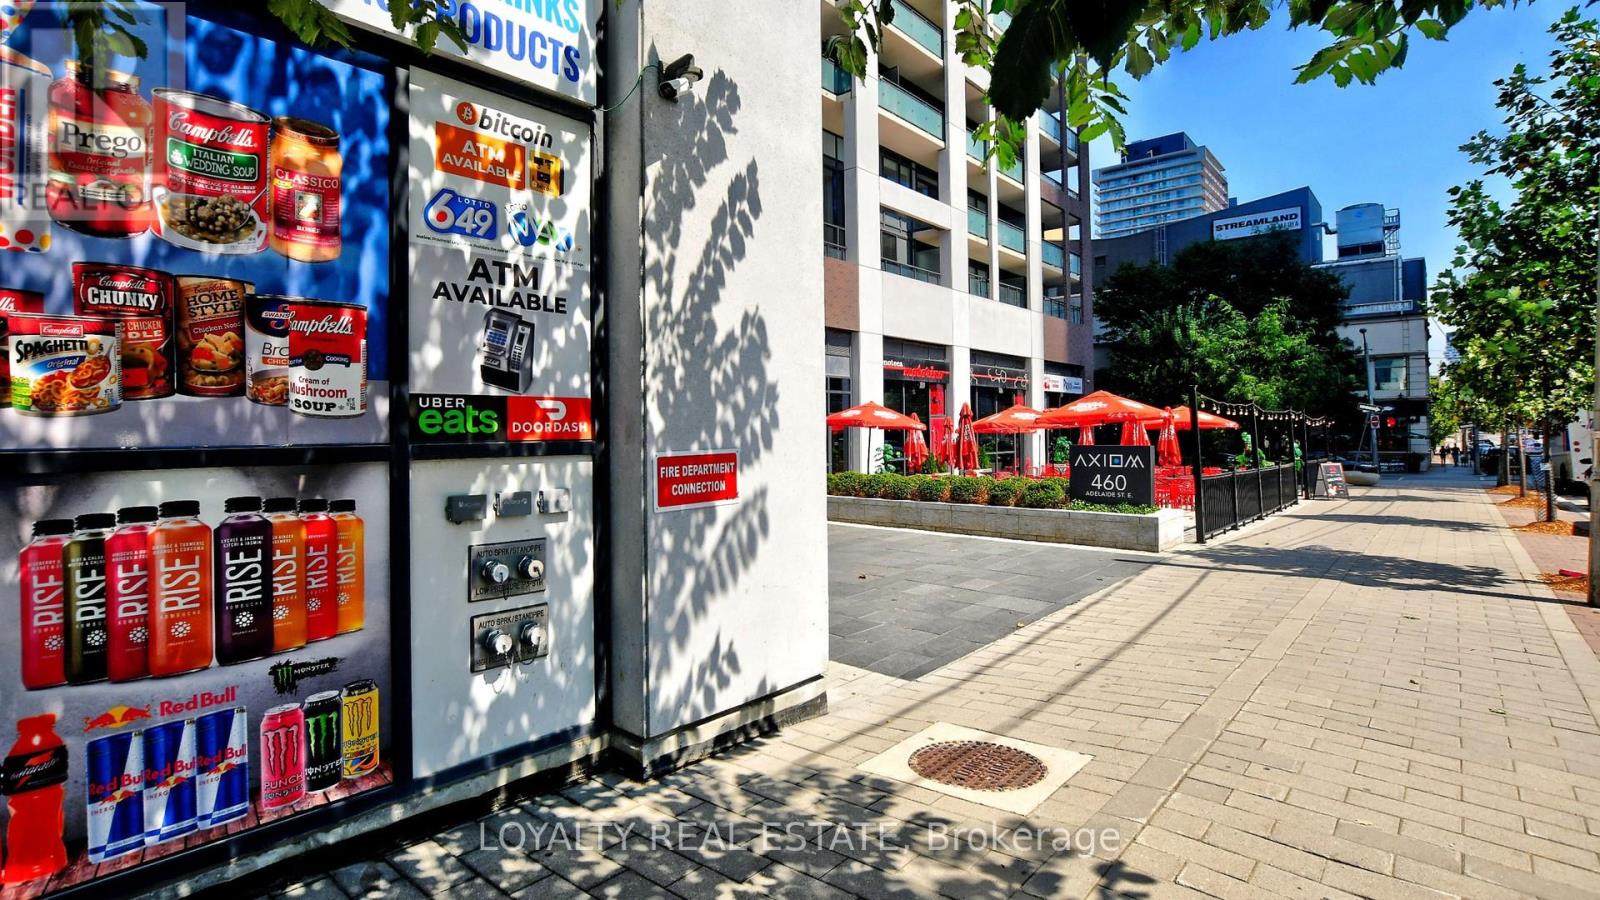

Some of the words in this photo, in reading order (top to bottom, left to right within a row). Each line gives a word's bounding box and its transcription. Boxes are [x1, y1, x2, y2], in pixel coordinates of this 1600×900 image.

[412, 0, 580, 82] RODUCTS
[168, 111, 257, 148] Campbell's
[478, 108, 553, 149] bitcoin
[62, 121, 142, 158] Prego
[192, 147, 235, 164] ITALIAN
[462, 139, 506, 163] ATM
[183, 153, 231, 177] WEDDING
[232, 166, 256, 178] SOUP
[442, 153, 522, 183] AVAILABLE
[275, 168, 339, 189] CLASSICO
[457, 197, 491, 209] LOTTO
[1215, 213, 1299, 232] STREAMLAND
[99, 275, 146, 290] Campbell's
[468, 258, 539, 290] ATM
[87, 286, 159, 310] CHUNKY
[186, 289, 238, 307] HOME
[432, 281, 568, 315] AVAILABLE
[188, 301, 241, 317] STYLE
[42, 324, 80, 335] Campbell's
[127, 321, 161, 331] CHICKEN
[193, 326, 223, 334] Chicken
[298, 376, 320, 385] Cream
[289, 382, 348, 398] Mushroom
[294, 398, 337, 412] SOUP
[418, 397, 466, 408] UBER
[418, 405, 499, 435] eats
[512, 421, 588, 433] DOORDASH
[1074, 453, 1145, 469] AXIOM
[660, 466, 680, 479] FIRE
[681, 462, 736, 477] DEPARTMENT
[671, 480, 727, 496] CONNECTION
[1091, 473, 1127, 491] 460
[477, 550, 493, 558] AUTO
[160, 555, 200, 612] RISE
[225, 549, 262, 603] RISE
[75, 569, 105, 621] RISE
[117, 564, 148, 618] RISE
[33, 575, 63, 627] RISE
[478, 620, 496, 629] AUTO
[294, 662, 330, 675] MONSTER
[160, 694, 199, 716] Red
[200, 687, 236, 707] Bull
[197, 752, 223, 767] Red
[224, 743, 247, 761] Bull
[145, 766, 172, 780] Red
[264, 772, 304, 790] PUNCH
[89, 780, 117, 795] Red
